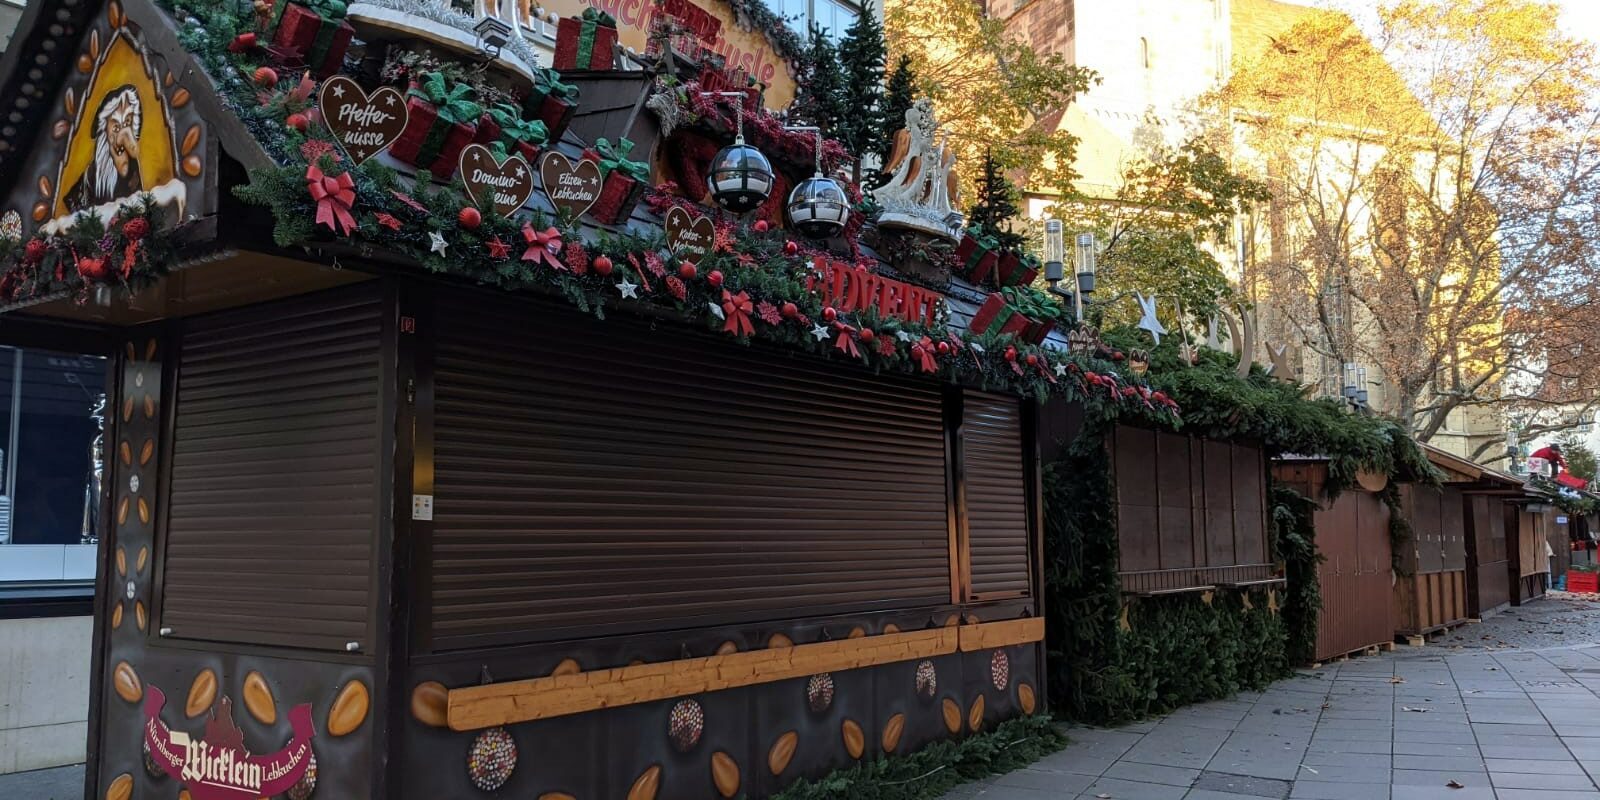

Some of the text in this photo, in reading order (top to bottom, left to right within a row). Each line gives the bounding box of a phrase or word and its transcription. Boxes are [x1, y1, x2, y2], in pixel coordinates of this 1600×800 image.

[338, 103, 396, 127] Pfeffer-
[344, 127, 385, 146] nüsse
[471, 168, 522, 188] Domino-
[559, 173, 587, 187] Elisen-
[552, 186, 593, 202] Lebkuchen
[678, 227, 703, 242] Kokos-
[806, 256, 946, 329] ADVENT
[147, 717, 307, 790] Nürnberger Wicklein Lebkuchen
